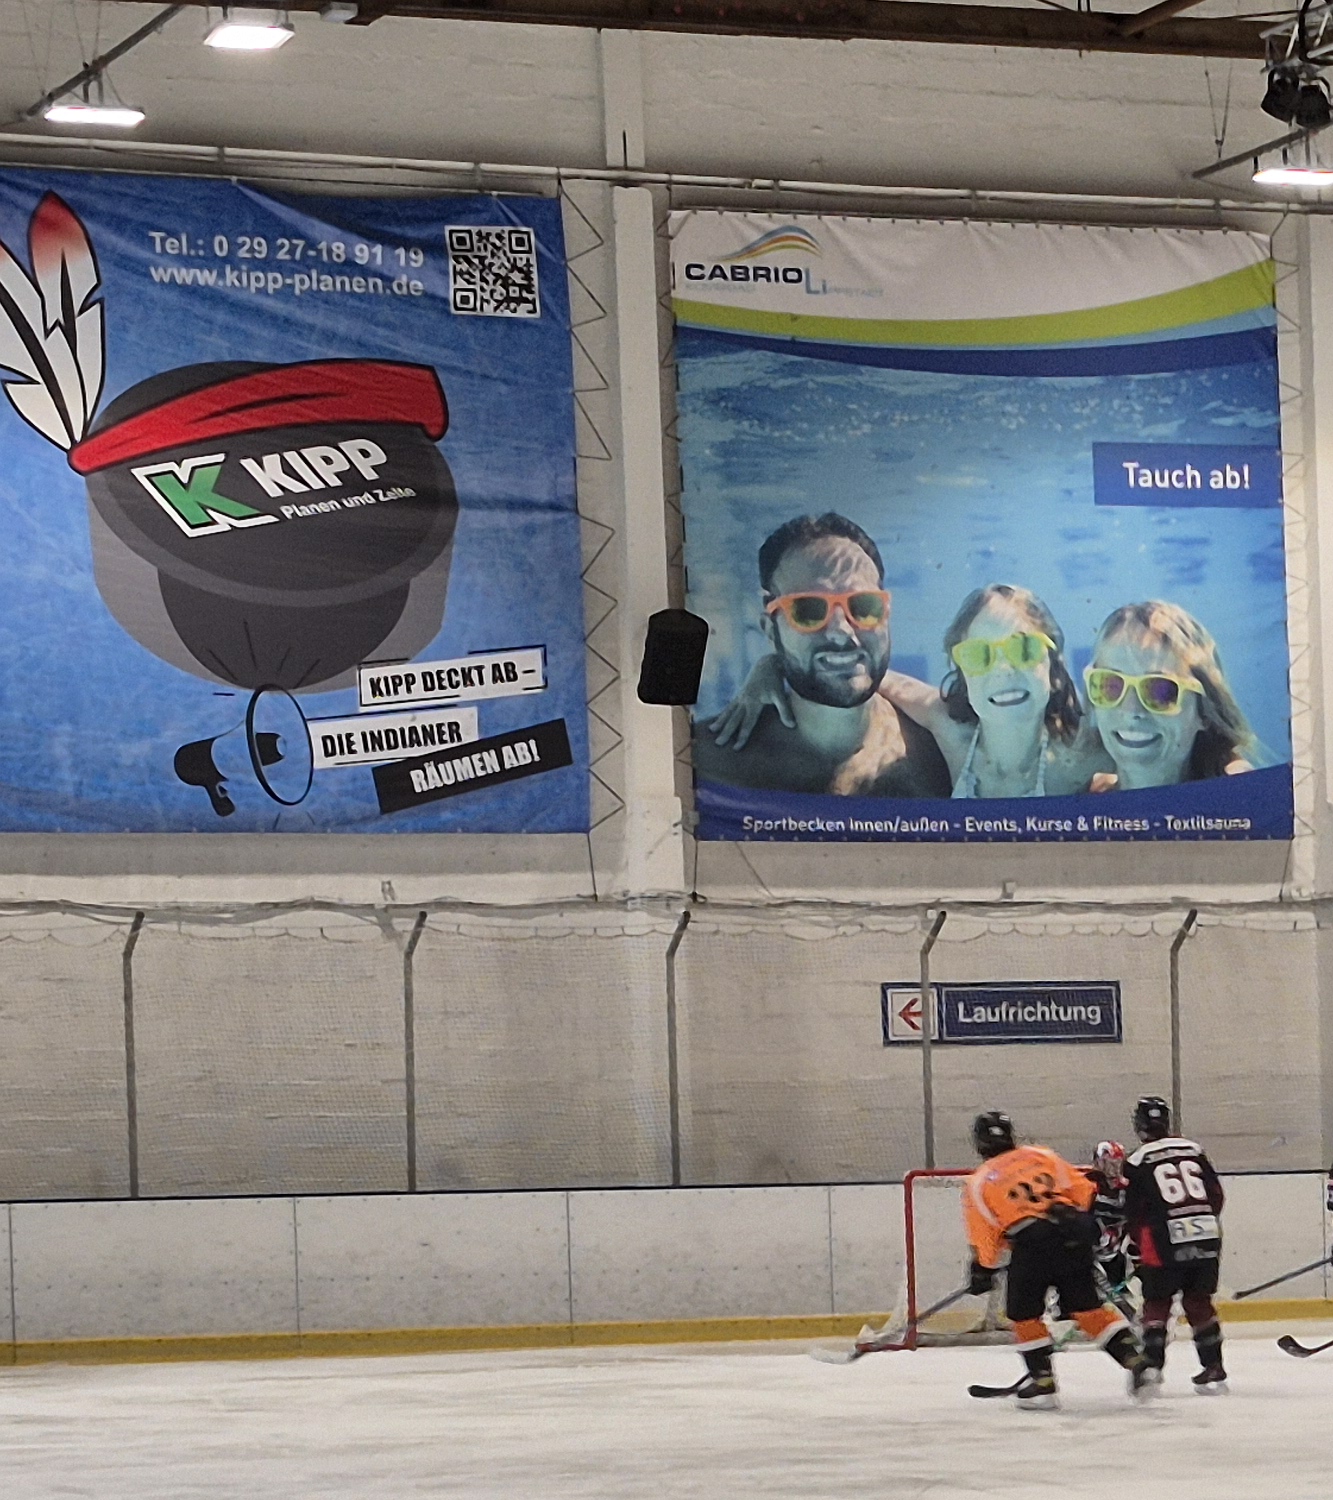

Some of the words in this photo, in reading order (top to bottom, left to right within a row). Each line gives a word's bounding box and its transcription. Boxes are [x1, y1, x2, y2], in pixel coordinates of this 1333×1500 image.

[149, 231, 204, 256] Tel.:
[213, 235, 229, 257] 0
[237, 236, 268, 259] 29
[275, 238, 347, 263] 27-18
[354, 243, 383, 265] 91
[395, 246, 425, 268] 19
[149, 264, 425, 297] www.kipp-planen.de
[684, 263, 804, 284] CABRIO
[239, 438, 388, 498] KIPP
[1122, 461, 1202, 489] Tauch
[1209, 463, 1250, 490] ab!
[279, 500, 343, 520] Planen
[341, 491, 377, 508] und
[369, 672, 417, 699] KIPP
[421, 664, 486, 692] DECKT
[491, 661, 519, 684] AB
[321, 732, 358, 758] DIE
[361, 721, 463, 753] INDIANER
[409, 748, 501, 793] RÄUMEN
[500, 738, 541, 769] AB!
[743, 815, 846, 833] Sportbecken
[849, 815, 949, 834] Innen/außen
[965, 816, 1022, 833] Events,
[1026, 816, 1073, 832] Kurse
[1077, 815, 1089, 832] &
[1093, 815, 1150, 832] Fitness
[958, 1001, 1102, 1025] Laufrichtung
[1153, 1160, 1208, 1204] 66
